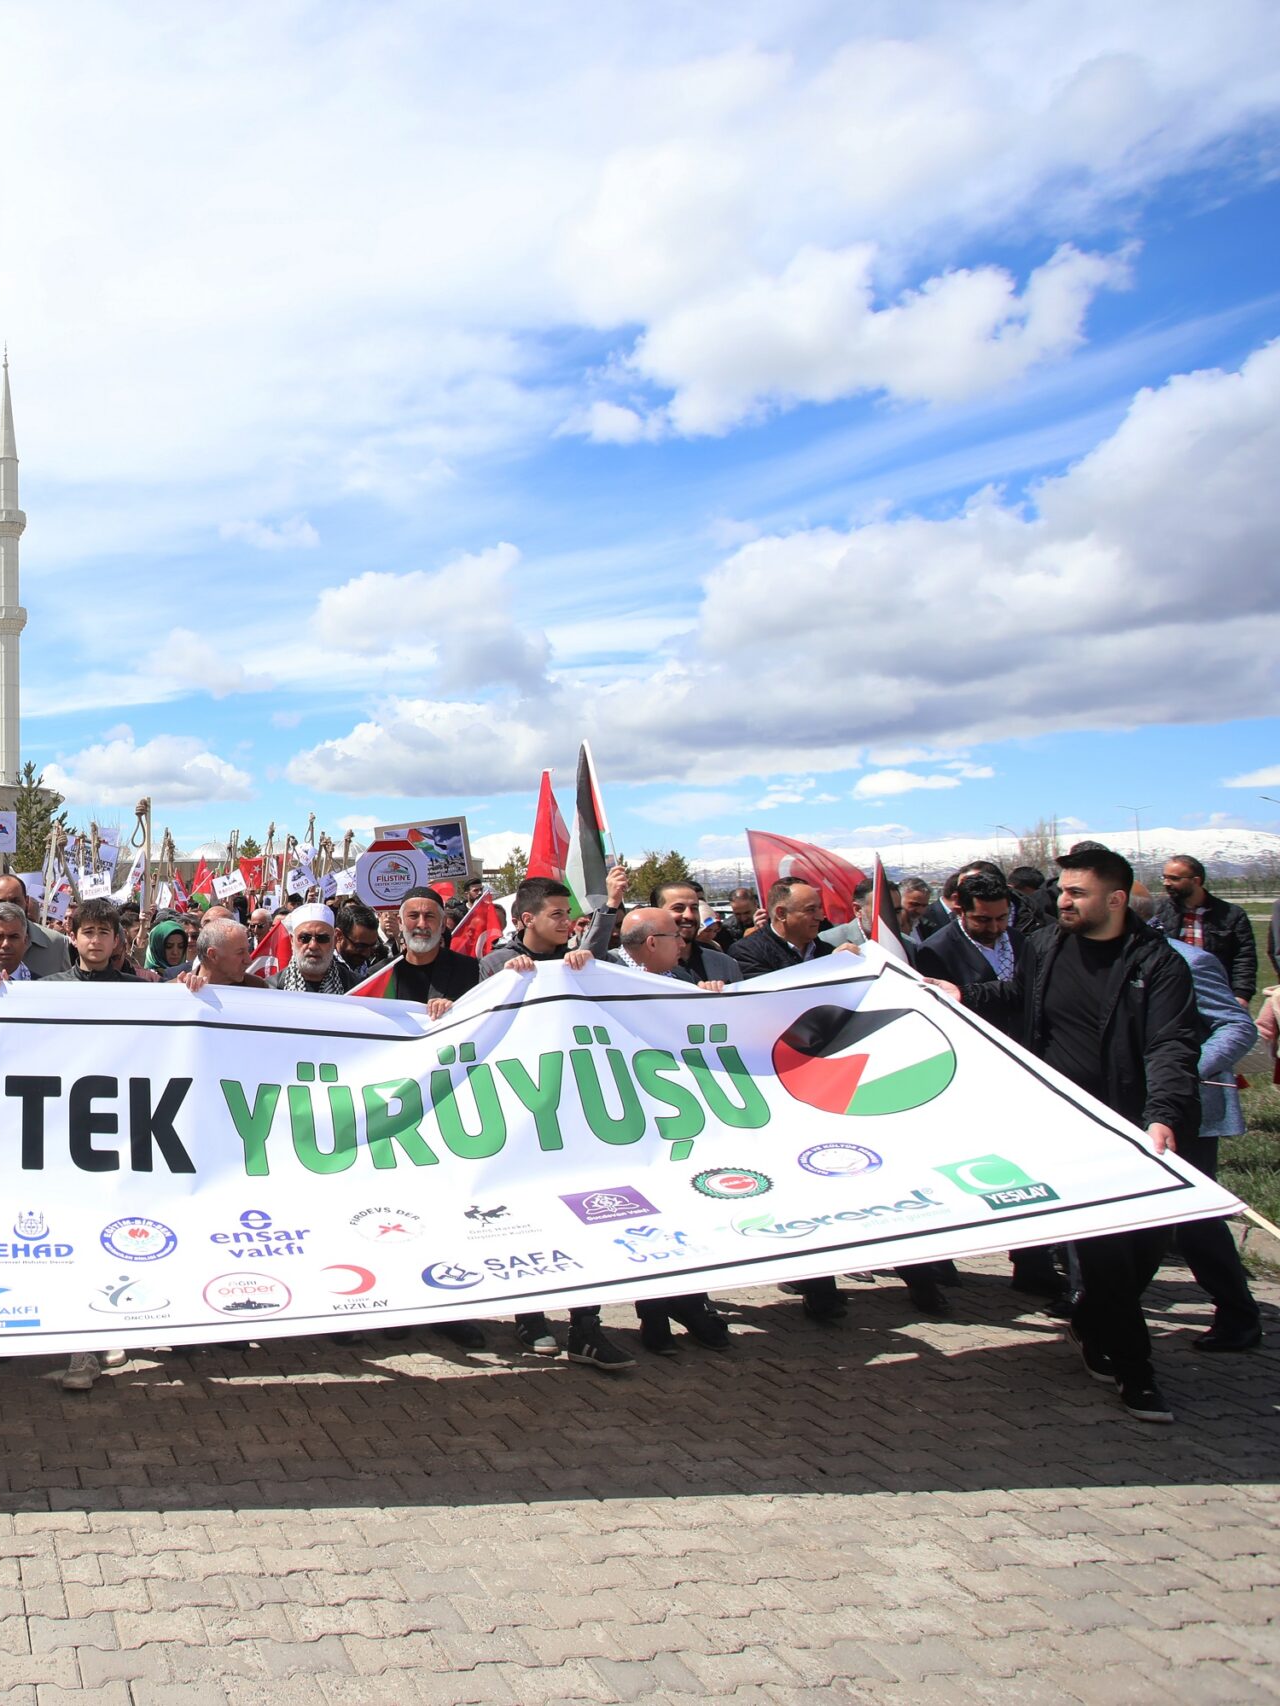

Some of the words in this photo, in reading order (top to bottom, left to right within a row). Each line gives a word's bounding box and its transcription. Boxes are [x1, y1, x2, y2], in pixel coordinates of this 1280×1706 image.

[219, 1024, 772, 1176] YÜRÜYÜŞÜ
[210, 1229, 311, 1244] ensar
[228, 1242, 305, 1259] vakfı
[483, 1249, 573, 1271] SAFA
[491, 1260, 585, 1281] VAKFI
[332, 1299, 389, 1311] KIZILAY
